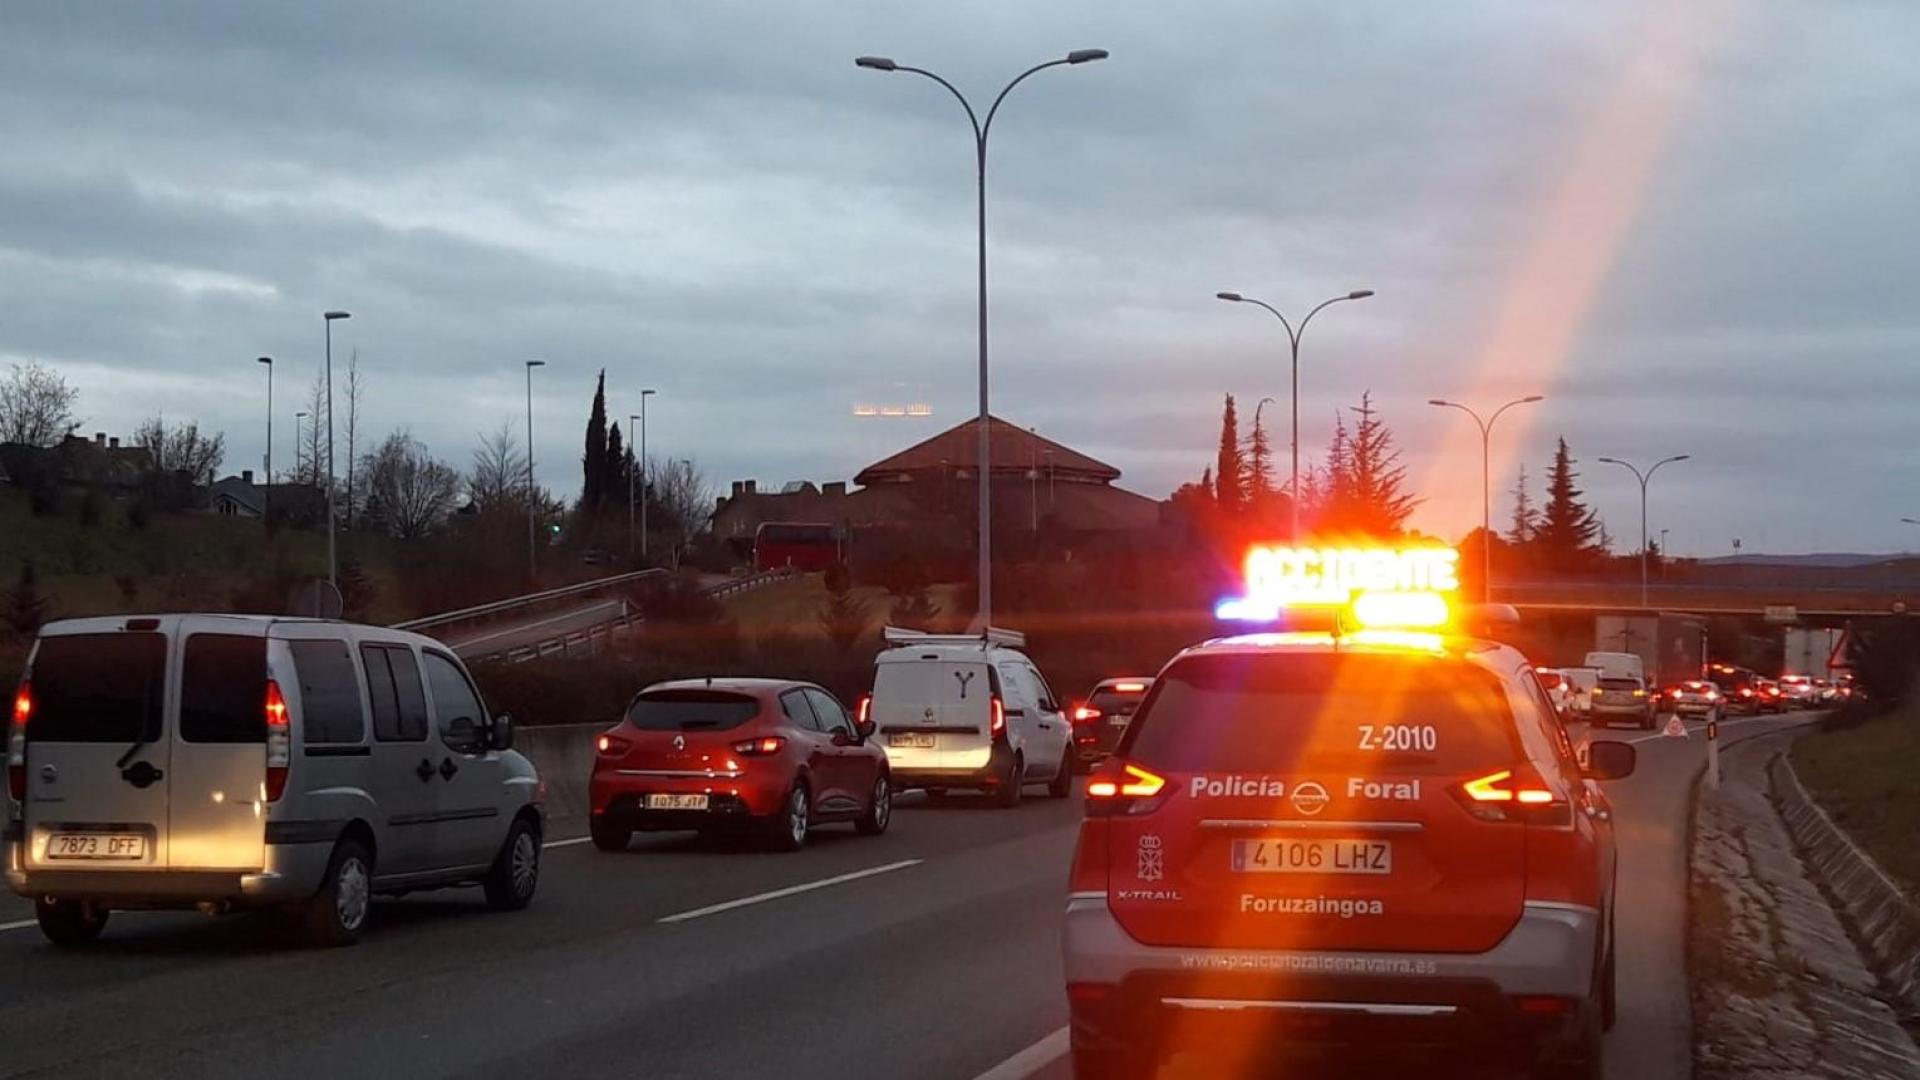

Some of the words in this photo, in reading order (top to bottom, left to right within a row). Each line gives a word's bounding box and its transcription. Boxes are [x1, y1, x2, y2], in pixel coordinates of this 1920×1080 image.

[1246, 546, 1459, 590] ACCIDENTE
[1358, 725, 1436, 750] Z-2010
[1190, 775, 1285, 797] Policía
[1347, 777, 1421, 800] Foral
[60, 837, 97, 853] 7873
[108, 838, 138, 853] DFF
[1253, 843, 1323, 867] 4106
[1334, 844, 1387, 869] LHZ
[1240, 894, 1384, 918] Foruzaingoa
